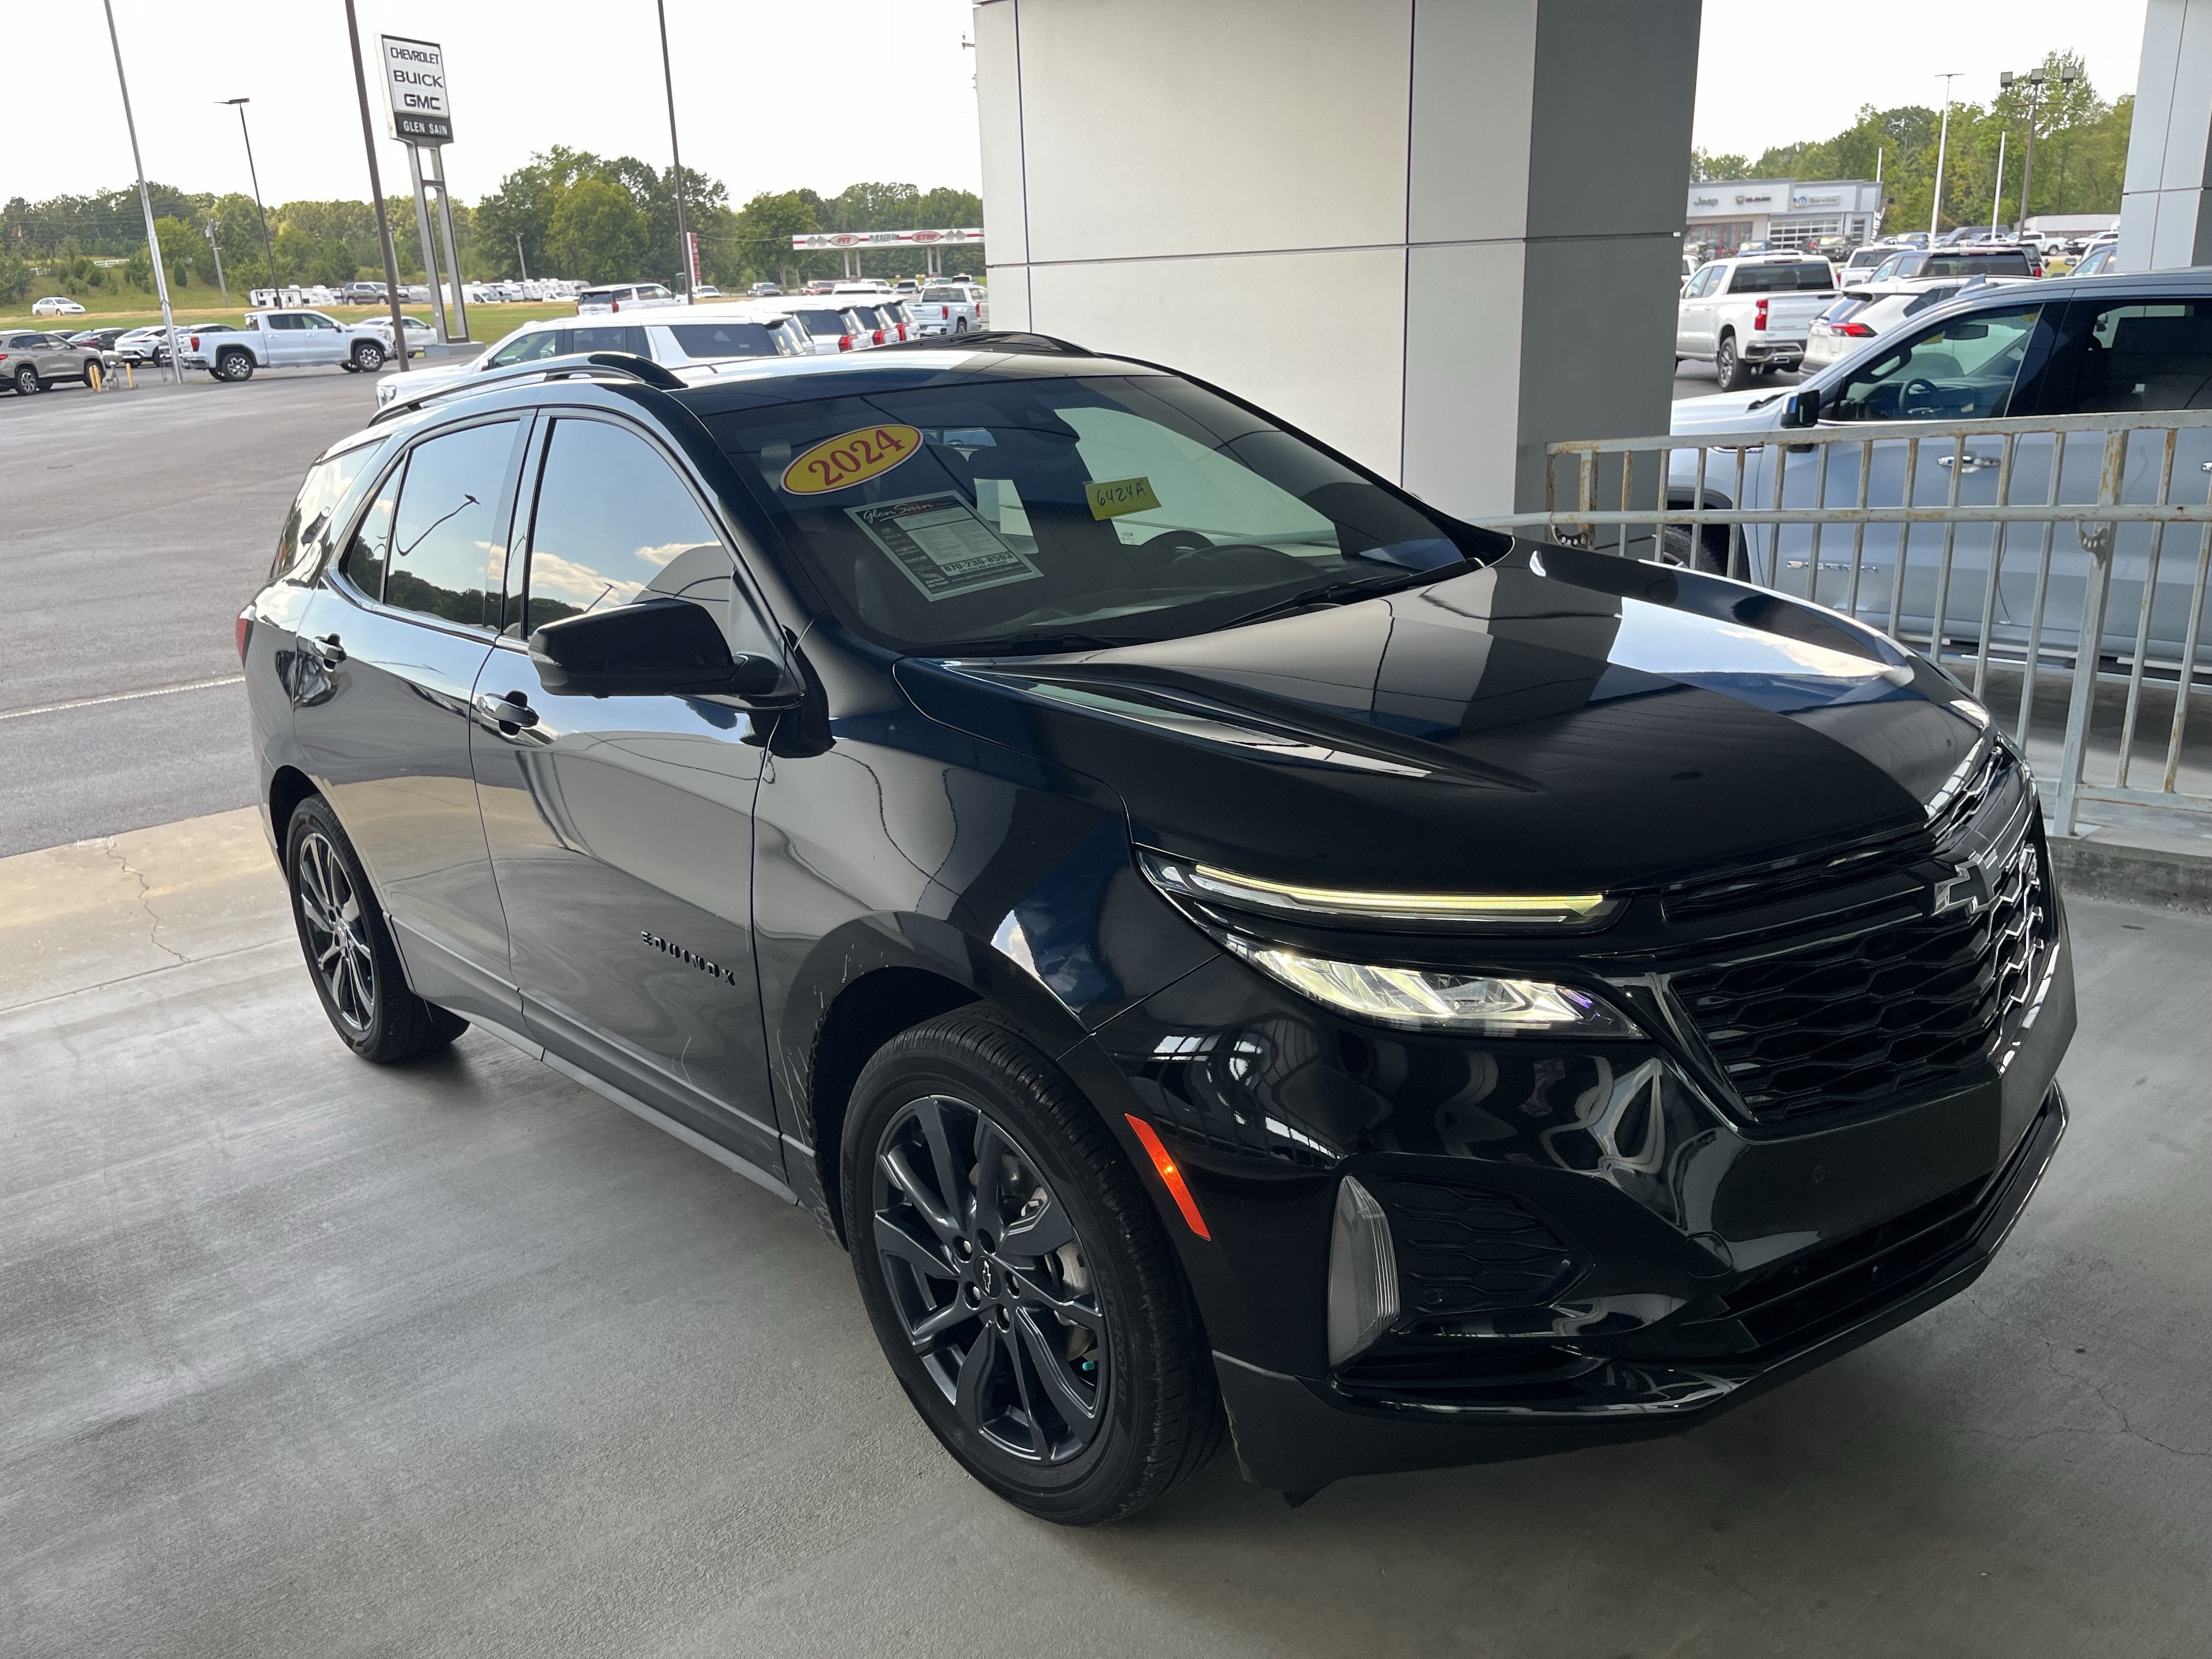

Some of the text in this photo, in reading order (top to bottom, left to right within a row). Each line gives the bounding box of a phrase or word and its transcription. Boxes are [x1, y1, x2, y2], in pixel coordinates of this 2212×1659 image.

[390, 47, 439, 64] CHEVROLET
[393, 70, 444, 88] BUICK
[404, 93, 441, 110] GMC
[403, 121, 448, 136] GLEN SAIN
[808, 430, 905, 486] 2024
[1097, 482, 1147, 507] 6424A
[894, 504, 934, 515] Sain
[943, 552, 1014, 572] 870-236-8503
[641, 930, 736, 986] EQUINOX
